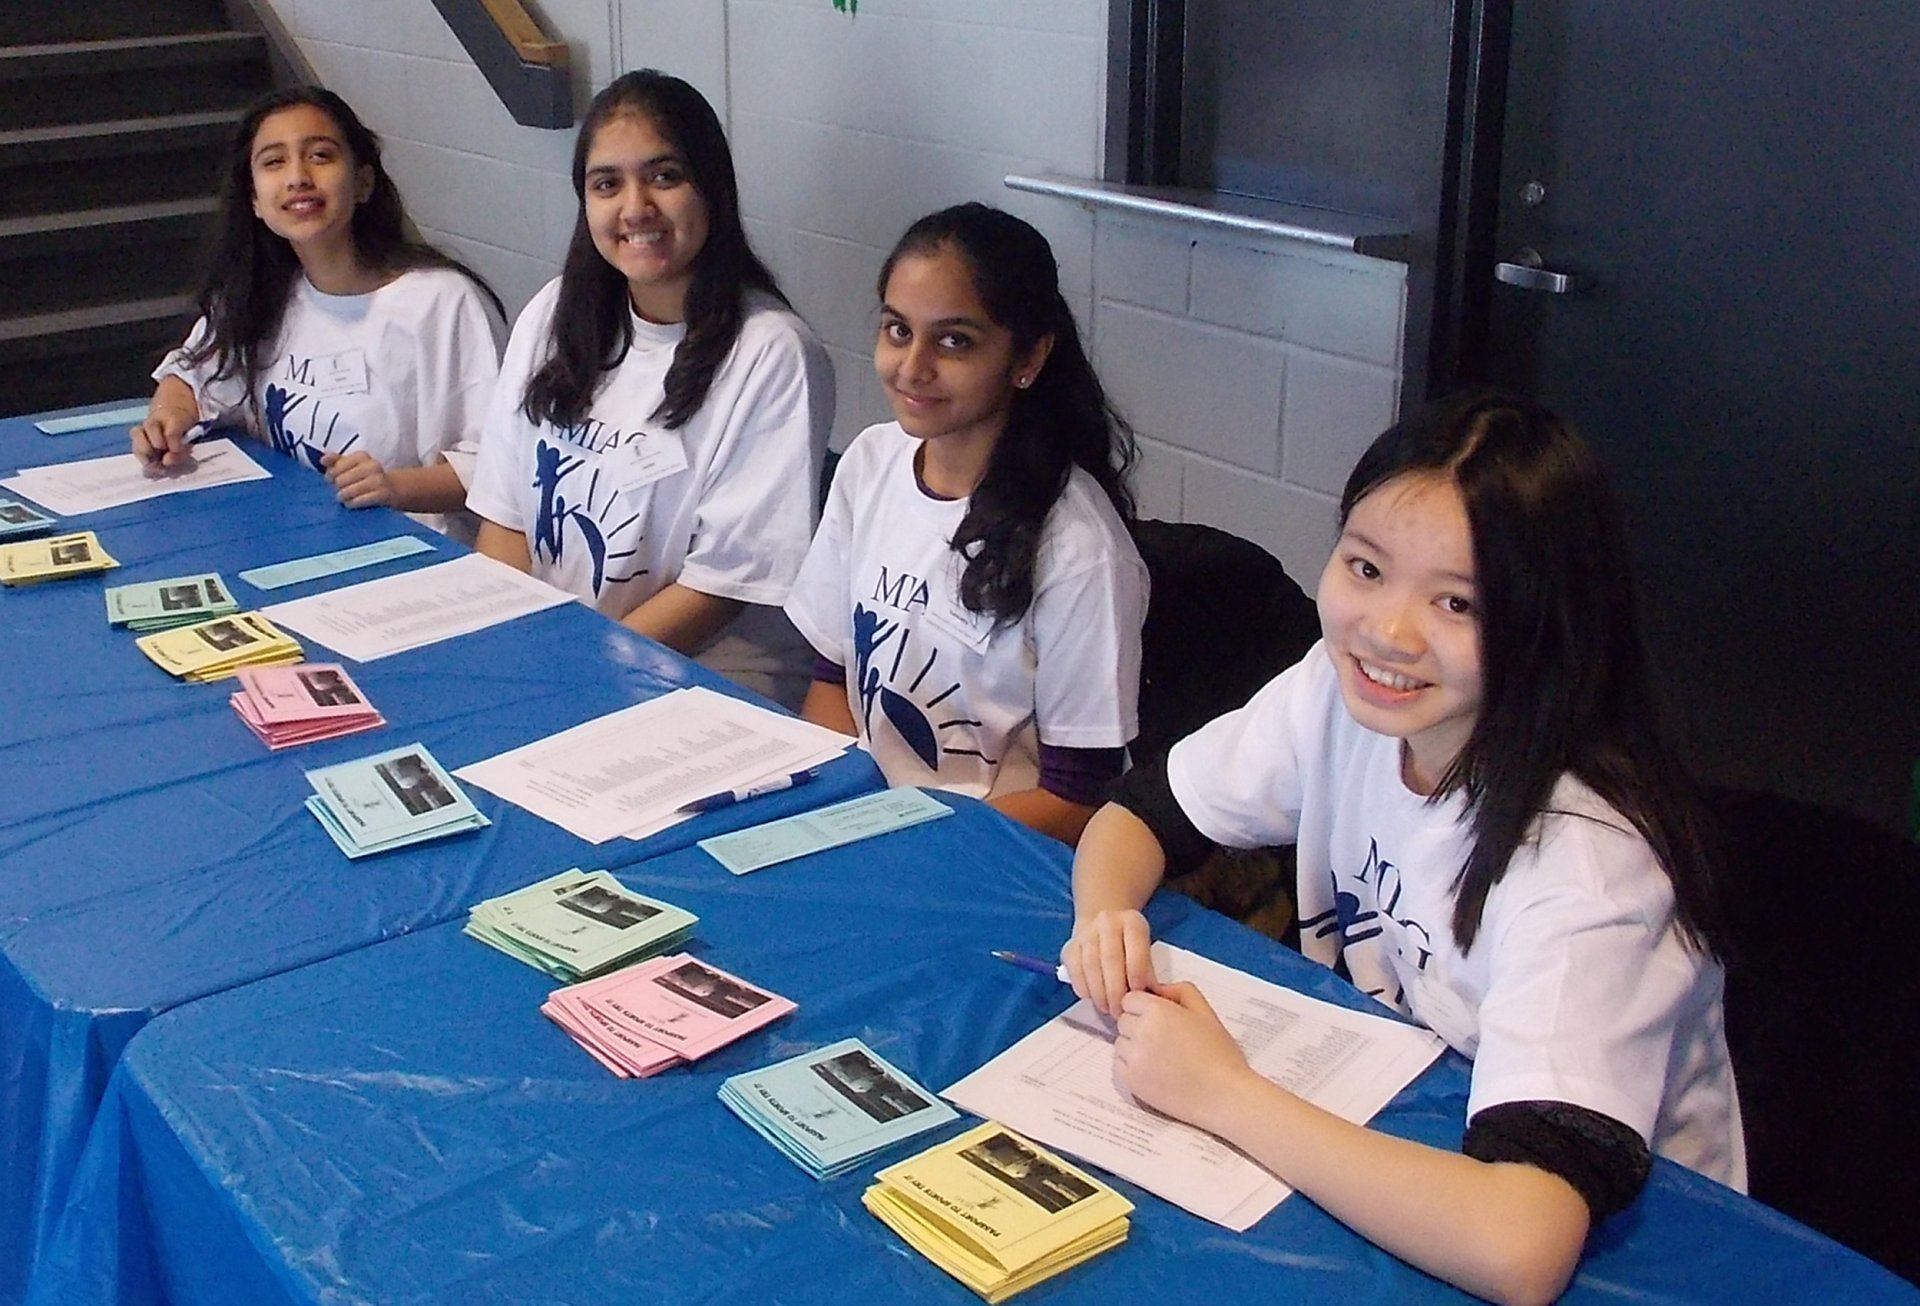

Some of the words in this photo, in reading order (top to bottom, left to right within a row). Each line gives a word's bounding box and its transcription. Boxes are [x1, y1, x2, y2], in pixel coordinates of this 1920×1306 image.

[768, 1097, 790, 1116] SPORTS
[794, 1120, 827, 1141] PASSPORT
[912, 1180, 925, 1190] TRY
[924, 1188, 952, 1206] SPORTS
[951, 1204, 962, 1214] TO
[961, 1212, 1001, 1237] PASSPORT
